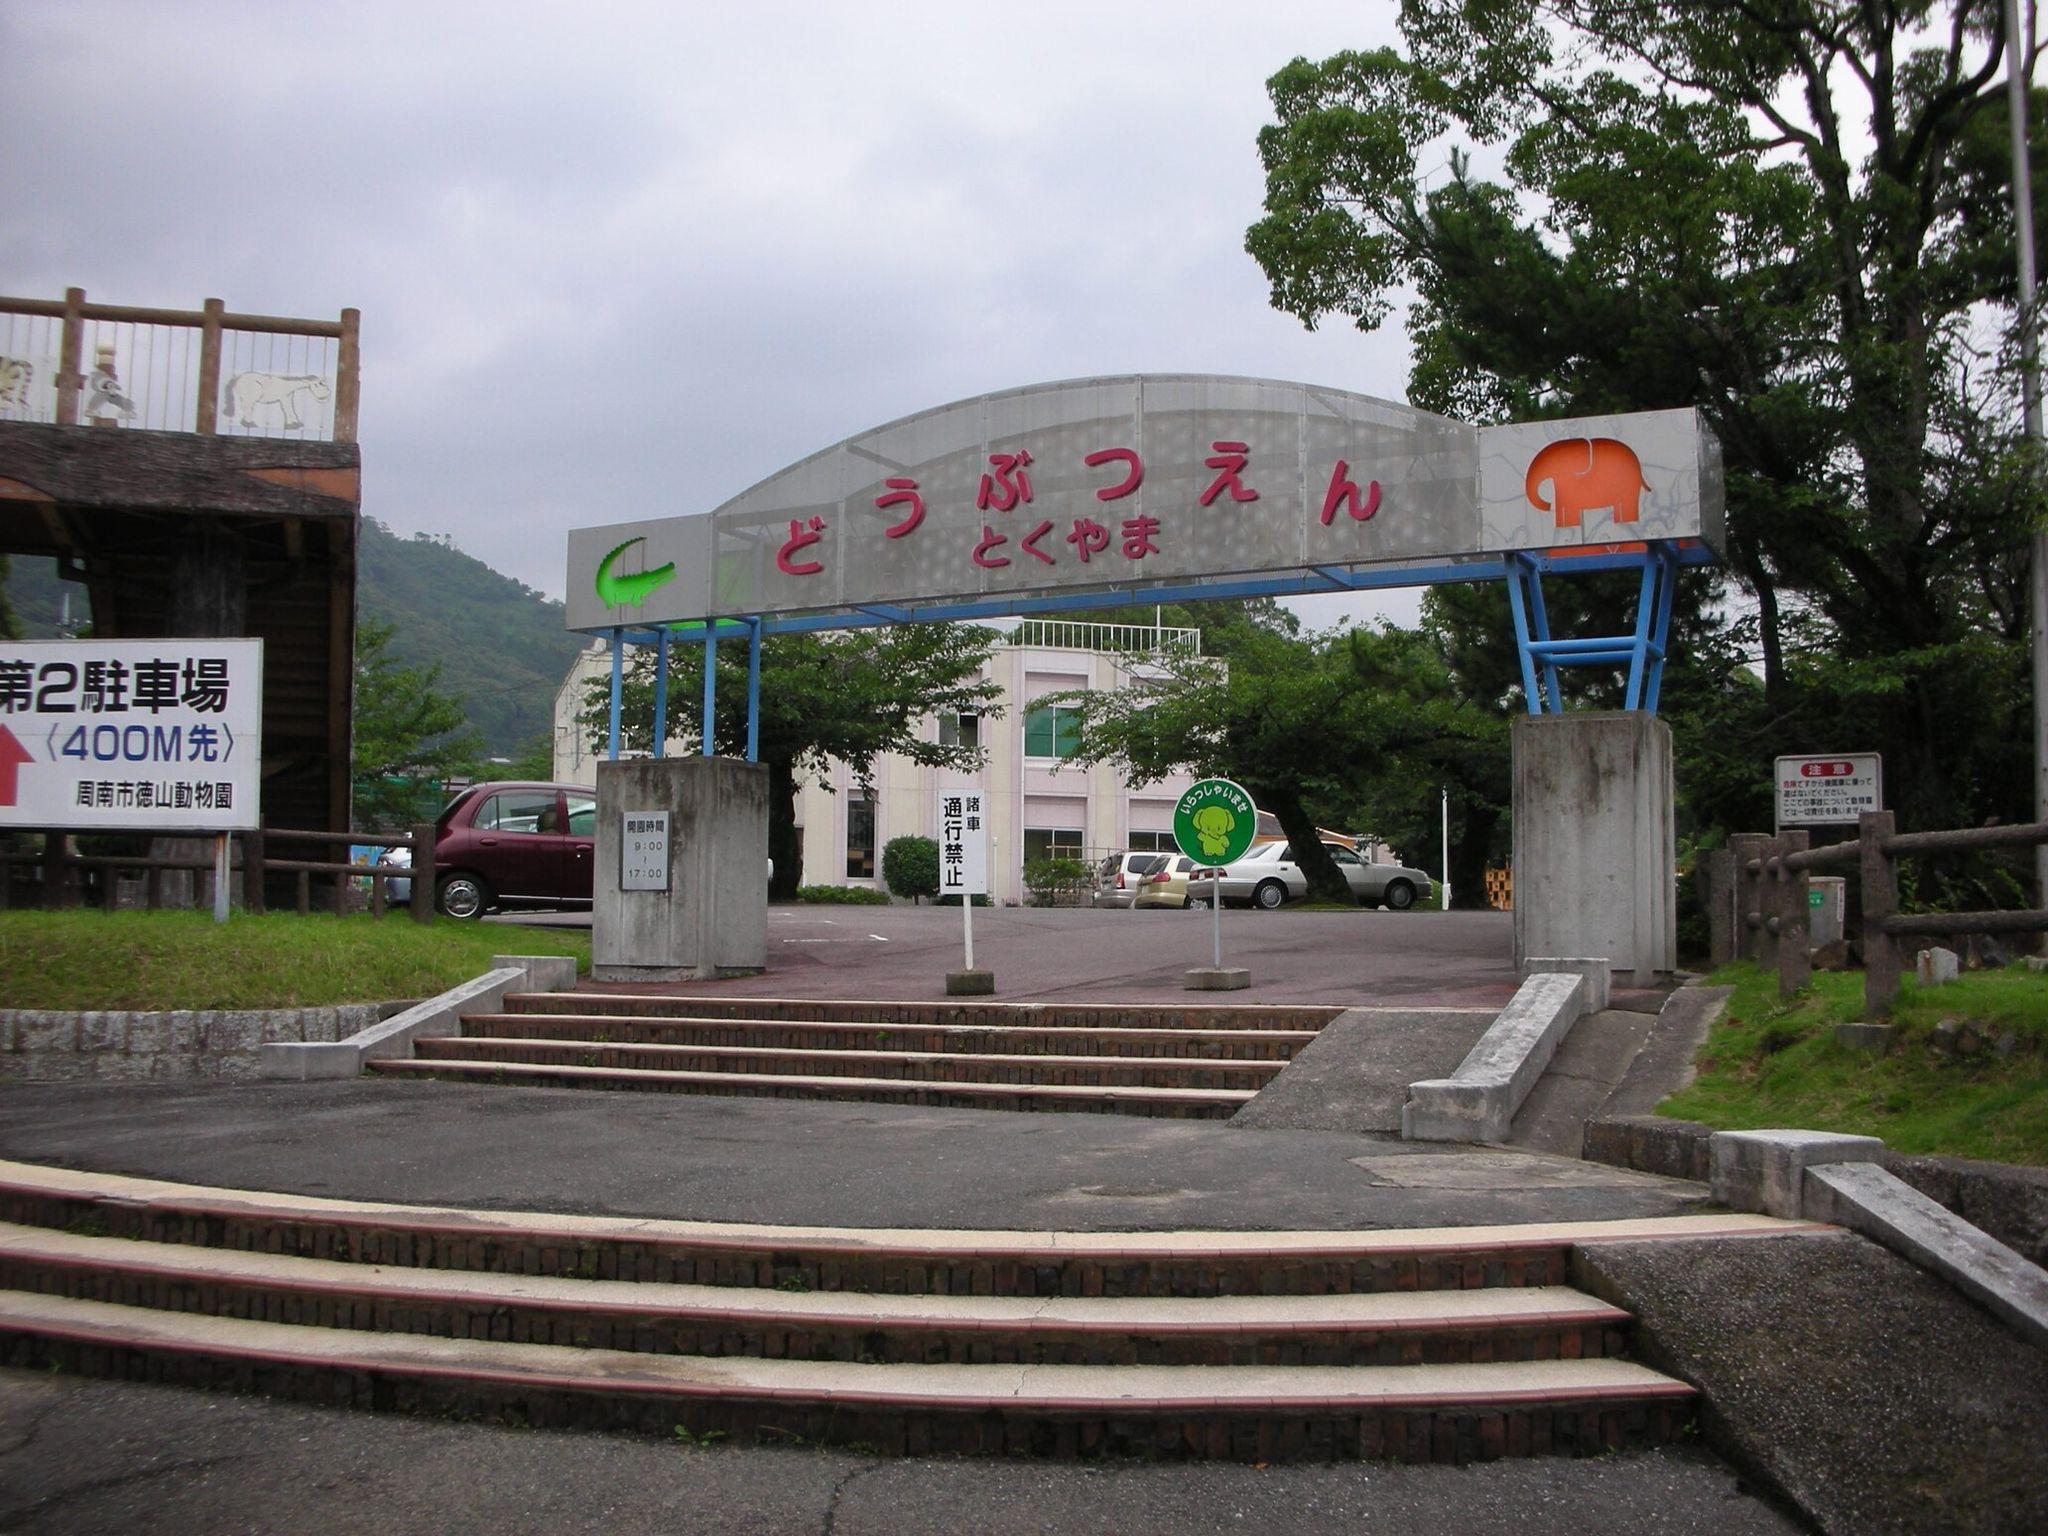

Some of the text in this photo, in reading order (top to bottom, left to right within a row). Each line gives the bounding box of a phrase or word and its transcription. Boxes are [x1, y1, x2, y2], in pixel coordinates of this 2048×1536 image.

[777, 440, 1382, 576] どうぶつえん
[972, 514, 1160, 569] とくやま
[0, 658, 230, 714] 第2駐車場
[76, 780, 233, 810] 周南市徳山動物園
[1180, 785, 1248, 815] いらっしゃいませ
[966, 796, 981, 832] 諸車
[634, 841, 663, 851] 9:00
[944, 797, 964, 887] 通行禁止
[628, 868, 662, 878] 17:00
